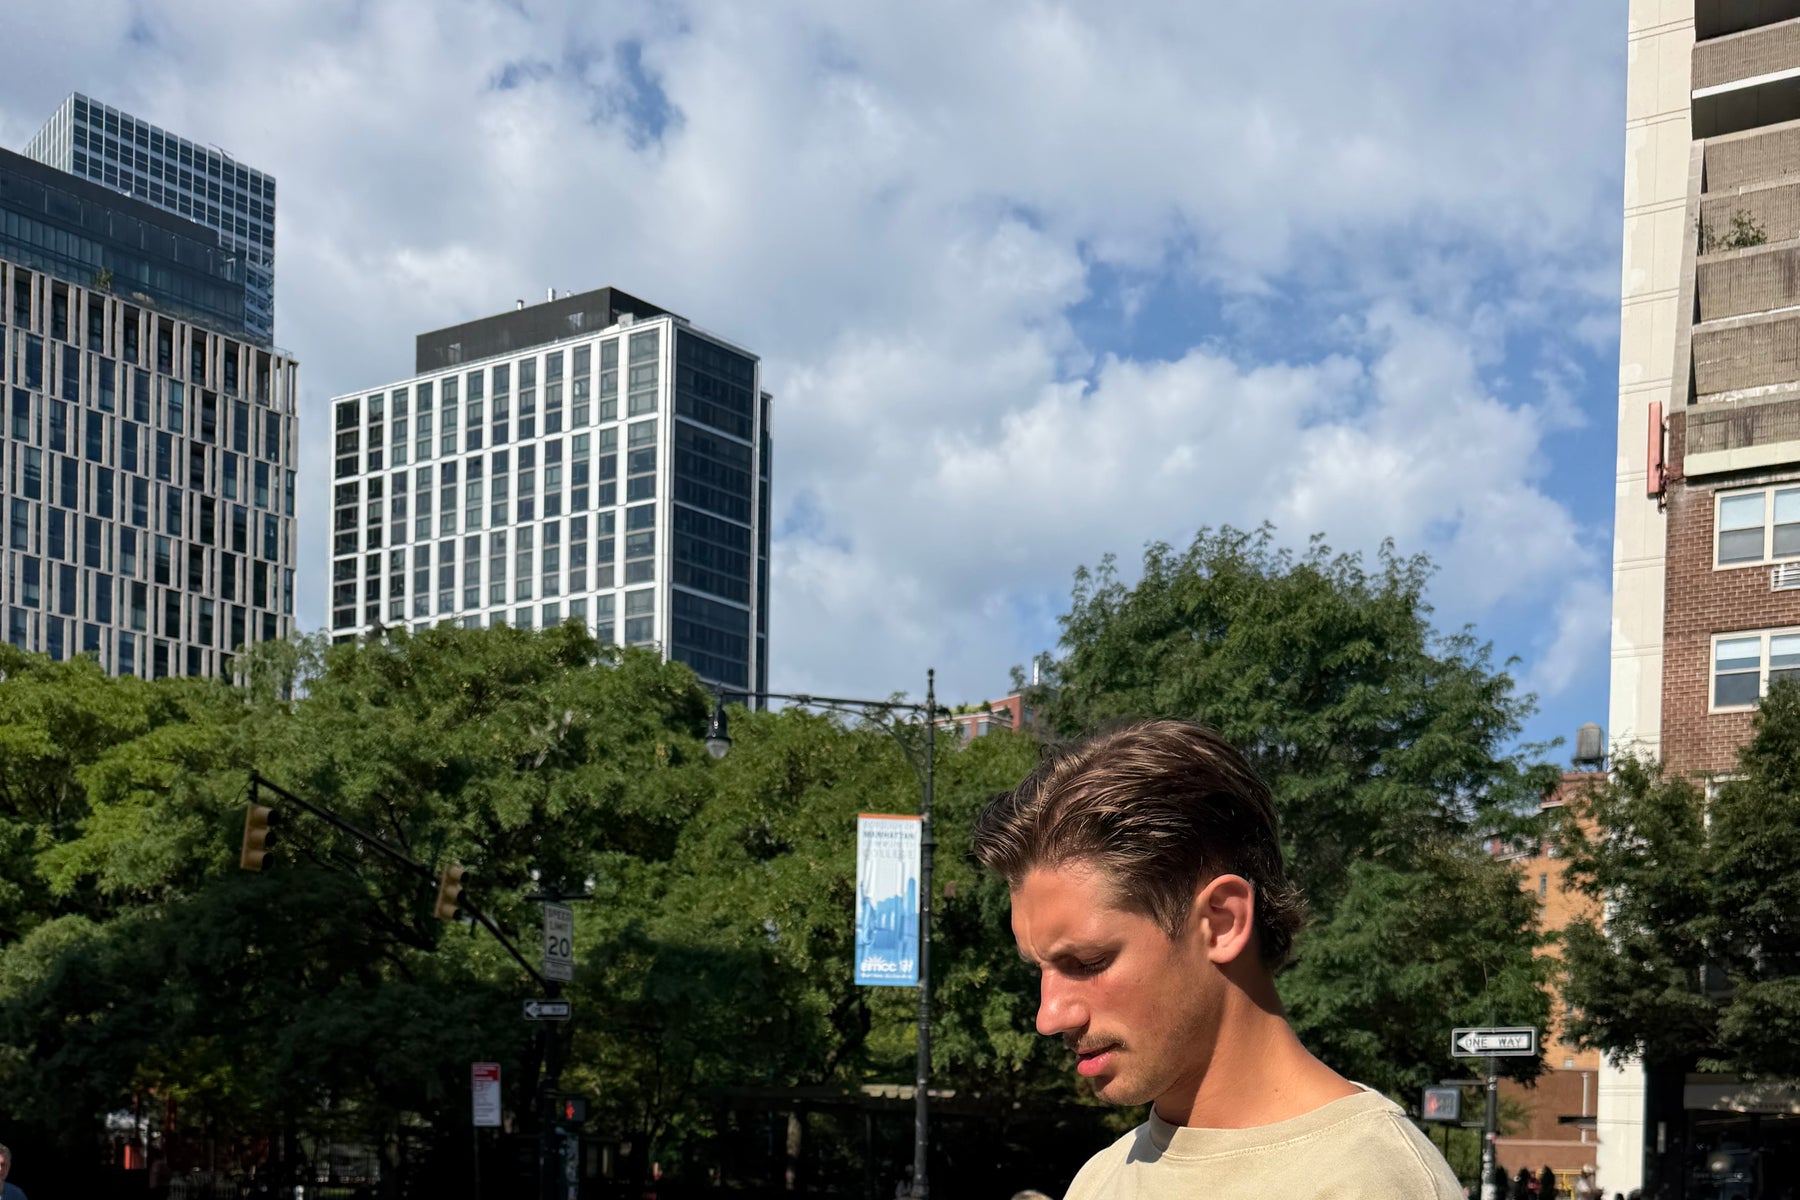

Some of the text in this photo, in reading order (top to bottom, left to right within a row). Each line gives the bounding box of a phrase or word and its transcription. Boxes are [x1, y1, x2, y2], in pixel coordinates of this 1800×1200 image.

[548, 935, 570, 958] 20
[1465, 1037, 1521, 1048] ONE WAY
